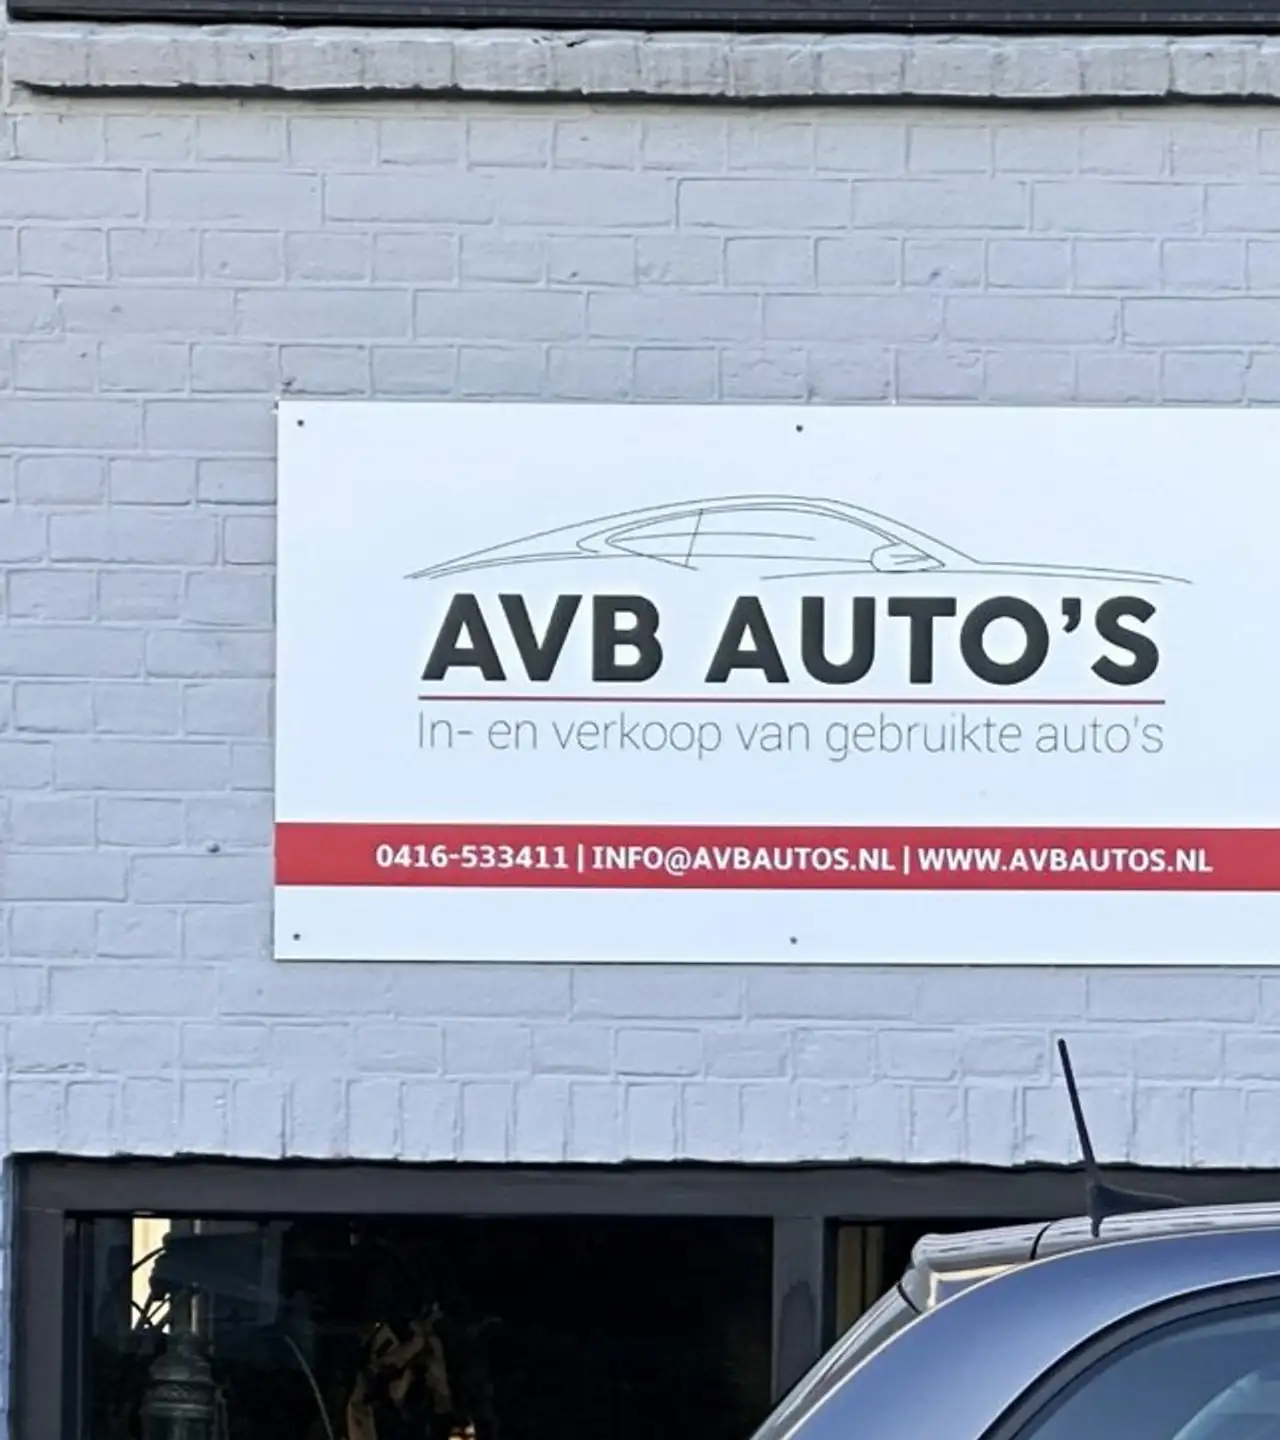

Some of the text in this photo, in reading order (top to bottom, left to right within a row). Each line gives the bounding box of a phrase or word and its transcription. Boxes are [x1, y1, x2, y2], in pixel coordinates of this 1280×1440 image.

[421, 593, 1160, 686] AVB AUTO'S
[418, 711, 1165, 762] In- en verkoop van gebruikte auto's
[375, 843, 570, 871] 0416-533411
[592, 845, 896, 876] INFO@AVBAUTOS.NL
[917, 847, 1213, 873] WWW.AVBAUTOS.NL
